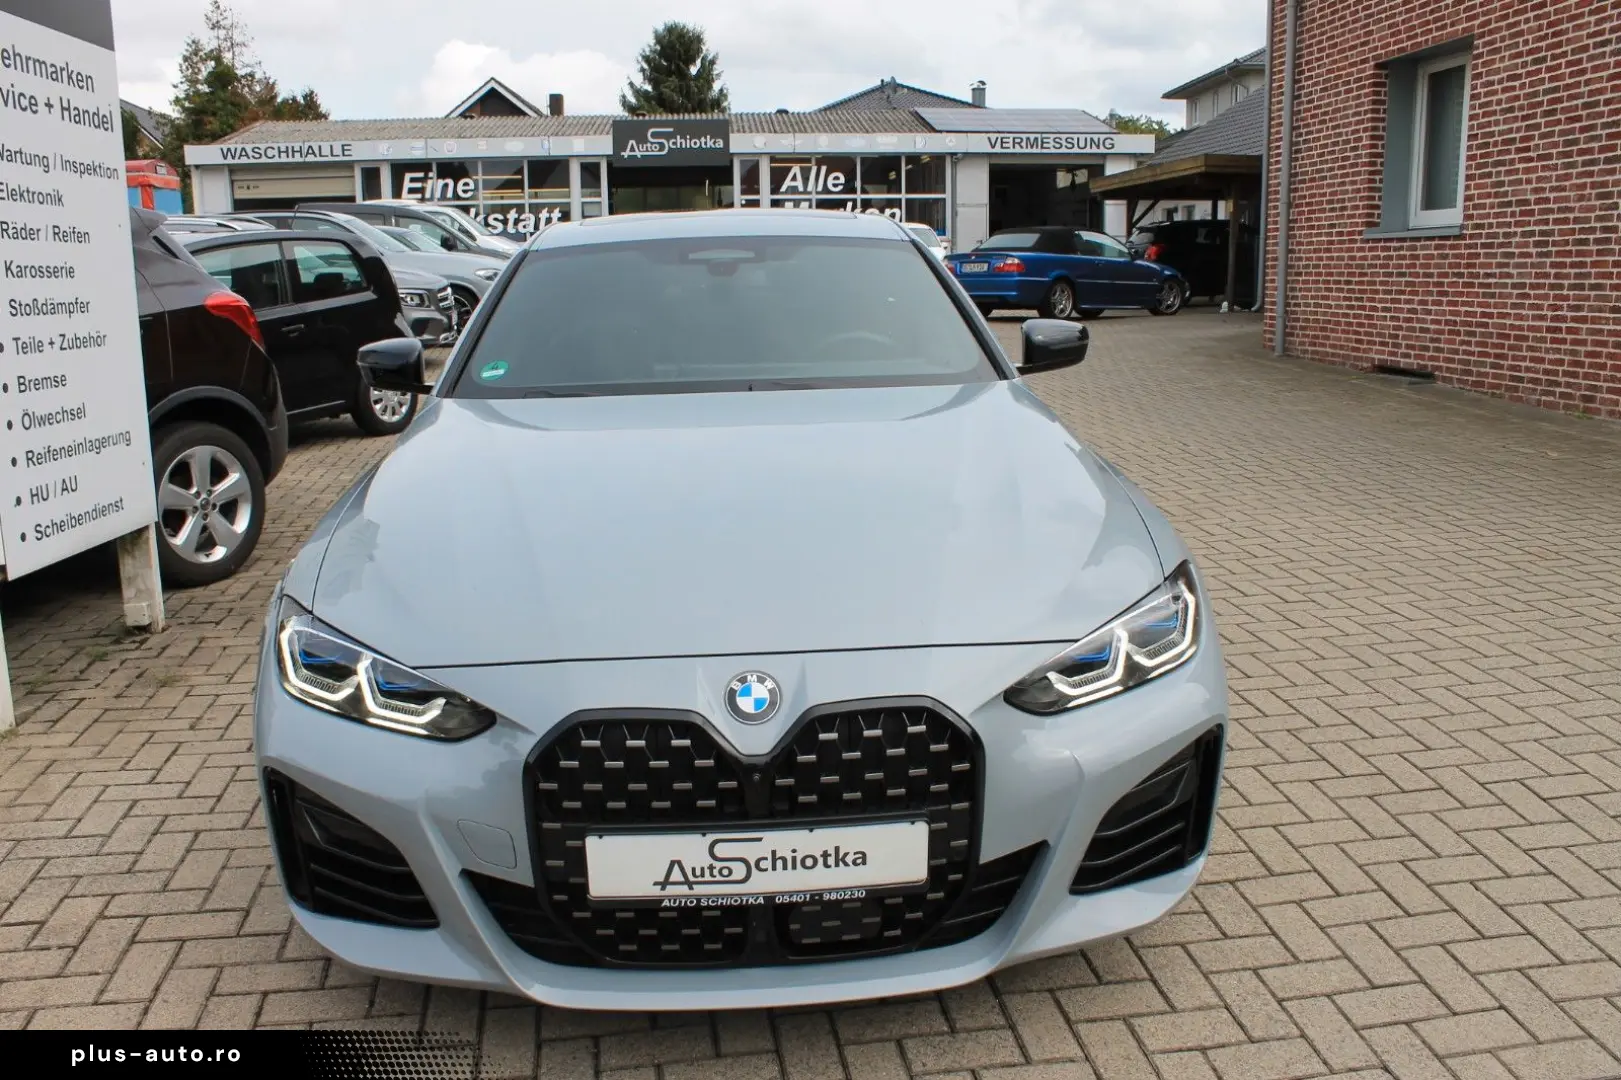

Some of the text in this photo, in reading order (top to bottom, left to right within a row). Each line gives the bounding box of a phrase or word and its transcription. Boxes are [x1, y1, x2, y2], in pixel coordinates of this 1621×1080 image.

[60, 96, 115, 133] Handel
[220, 143, 353, 161] WASCHHALLE
[987, 136, 1116, 151] VERMESSUNG
[60, 153, 120, 180] Inspektion
[779, 165, 845, 192] Alle
[401, 171, 476, 200] Eine
[1, 220, 41, 243] Räder
[52, 225, 91, 244] Reifen
[4, 259, 75, 280] Karosserie
[8, 298, 91, 319] Stoßdämpfer
[12, 336, 44, 356] Teile
[59, 331, 107, 352] Zubehör
[17, 372, 68, 393] Bremse
[21, 402, 87, 431] Ölwechsel
[25, 428, 132, 468] Reifeneinlagerung
[29, 483, 49, 506] HU
[60, 475, 78, 497] AU
[34, 496, 125, 541] Scheibendienst
[731, 674, 776, 691] BMW
[661, 897, 697, 907] AUTO
[700, 896, 765, 907] SCHIOTKA
[775, 893, 811, 904] 05401
[822, 890, 866, 902] 980230
